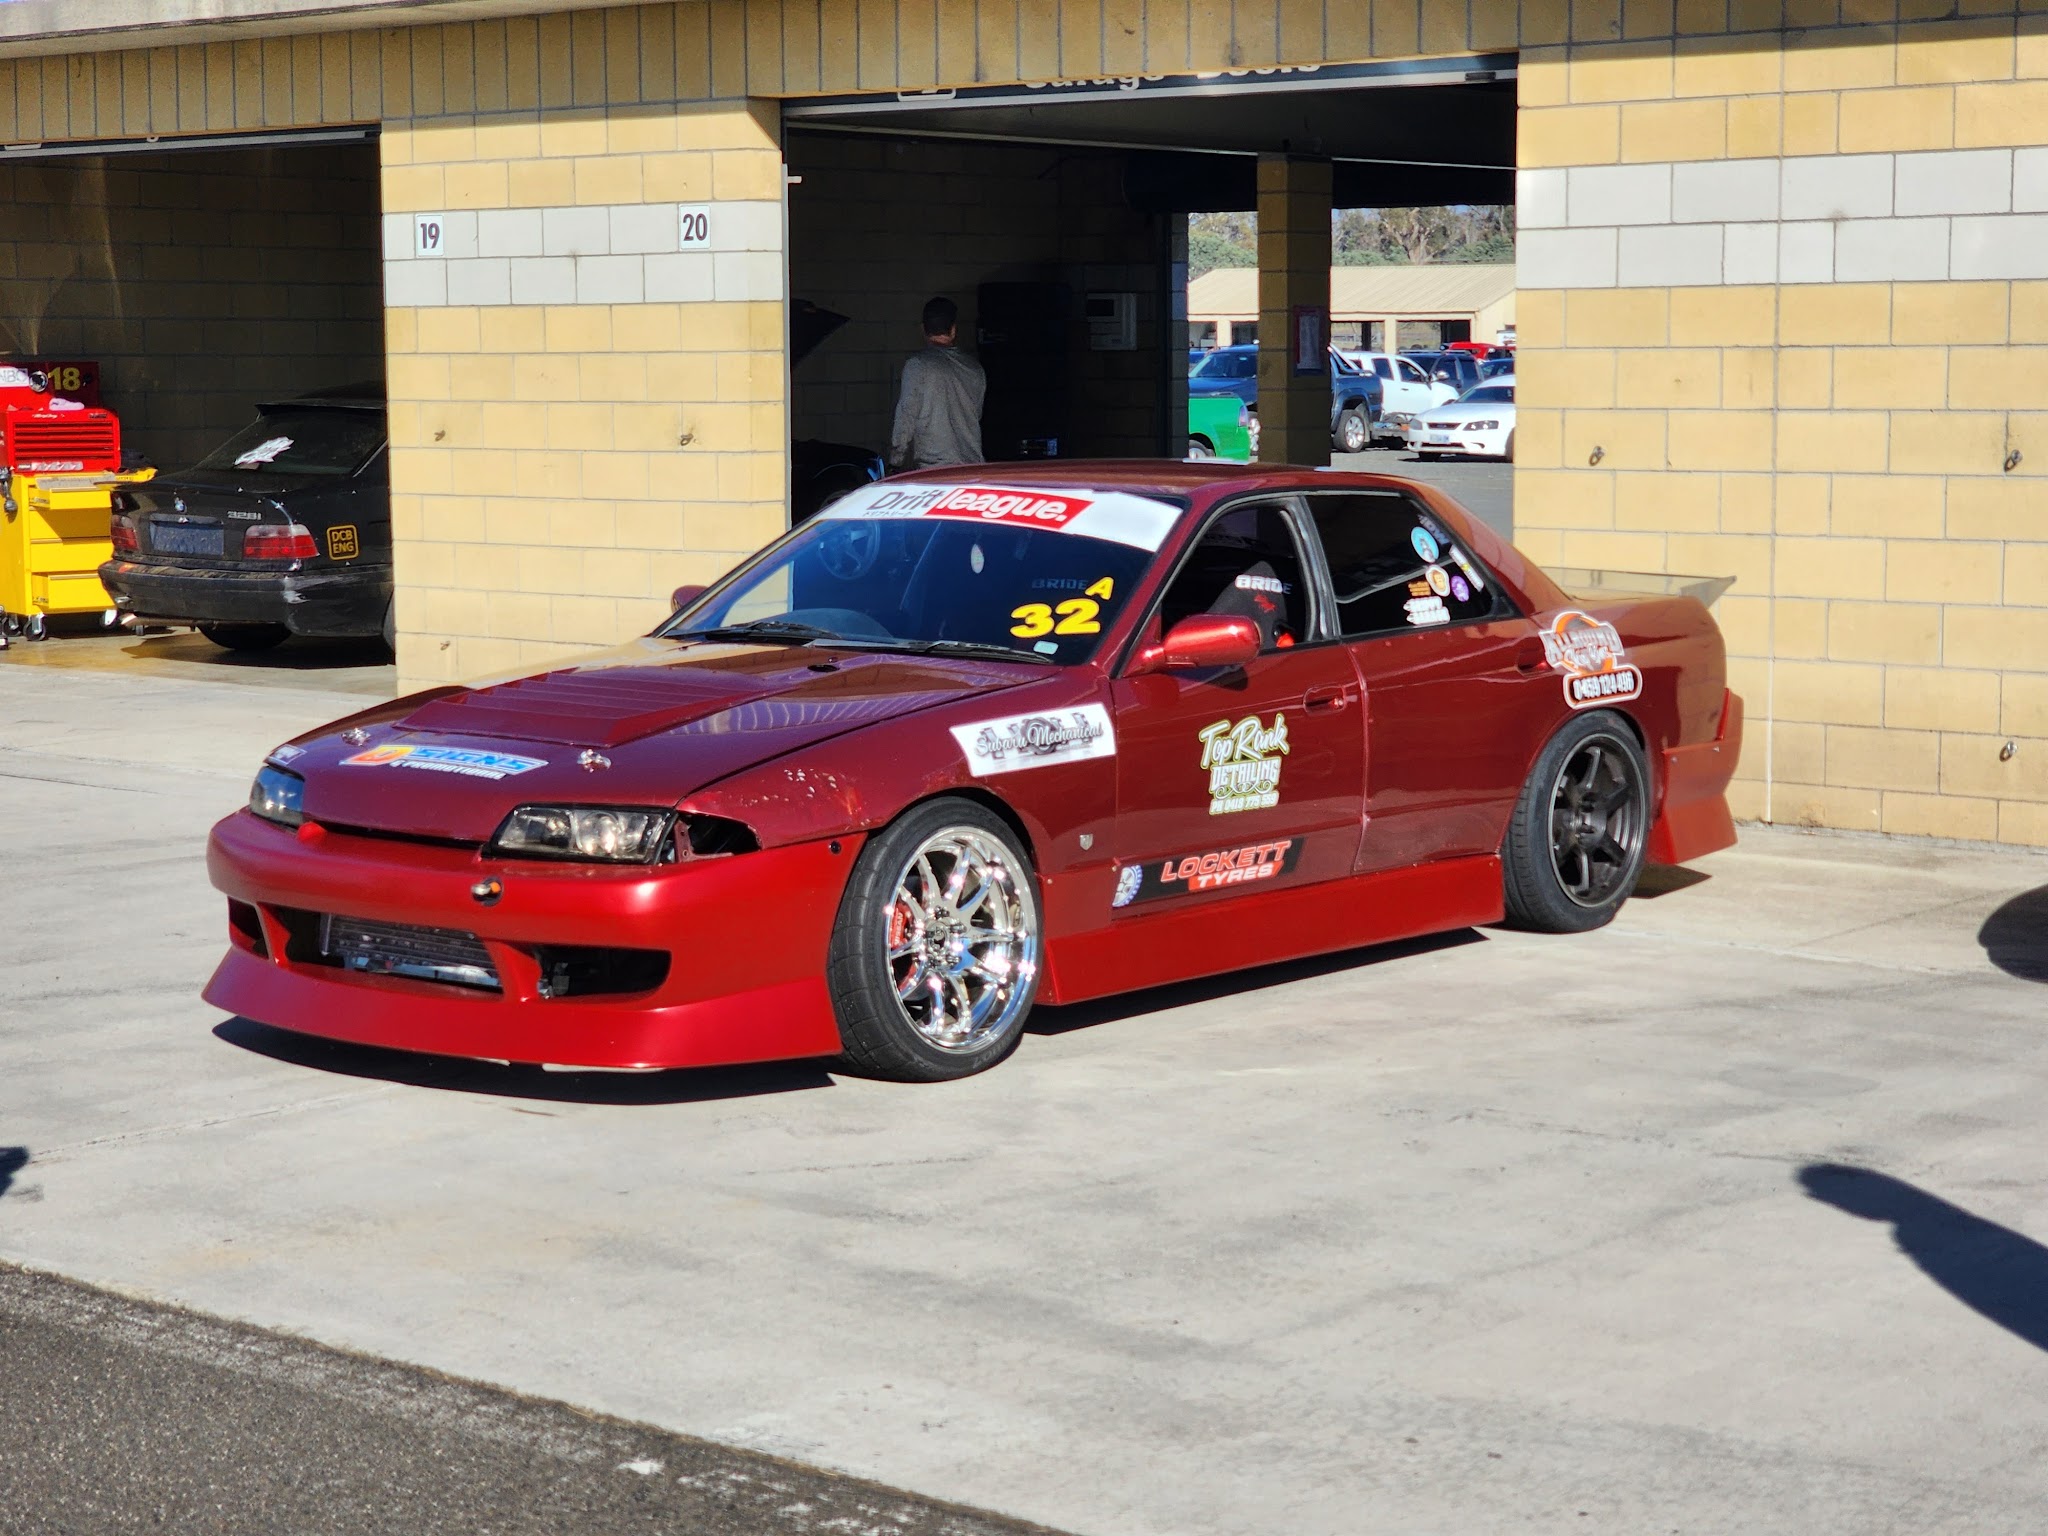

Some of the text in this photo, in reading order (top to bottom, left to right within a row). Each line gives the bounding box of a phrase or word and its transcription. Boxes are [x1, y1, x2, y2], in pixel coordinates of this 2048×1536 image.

[420, 223, 440, 249] 19
[683, 213, 708, 241] 20
[47, 367, 80, 391] 18
[866, 489, 945, 511] Drift
[332, 530, 353, 542] DCB
[333, 543, 354, 554] ENG
[1032, 579, 1088, 589] BRIDE
[1084, 576, 1114, 600] A
[1235, 574, 1292, 595] BRIDE
[1010, 598, 1101, 638] 32
[975, 721, 1105, 757] Subaru Mechanical
[1200, 714, 1288, 767] Top Rank
[1210, 758, 1279, 792] DETAILING
[1160, 840, 1292, 883] LOCKETT
[1196, 862, 1275, 889] TYRES
